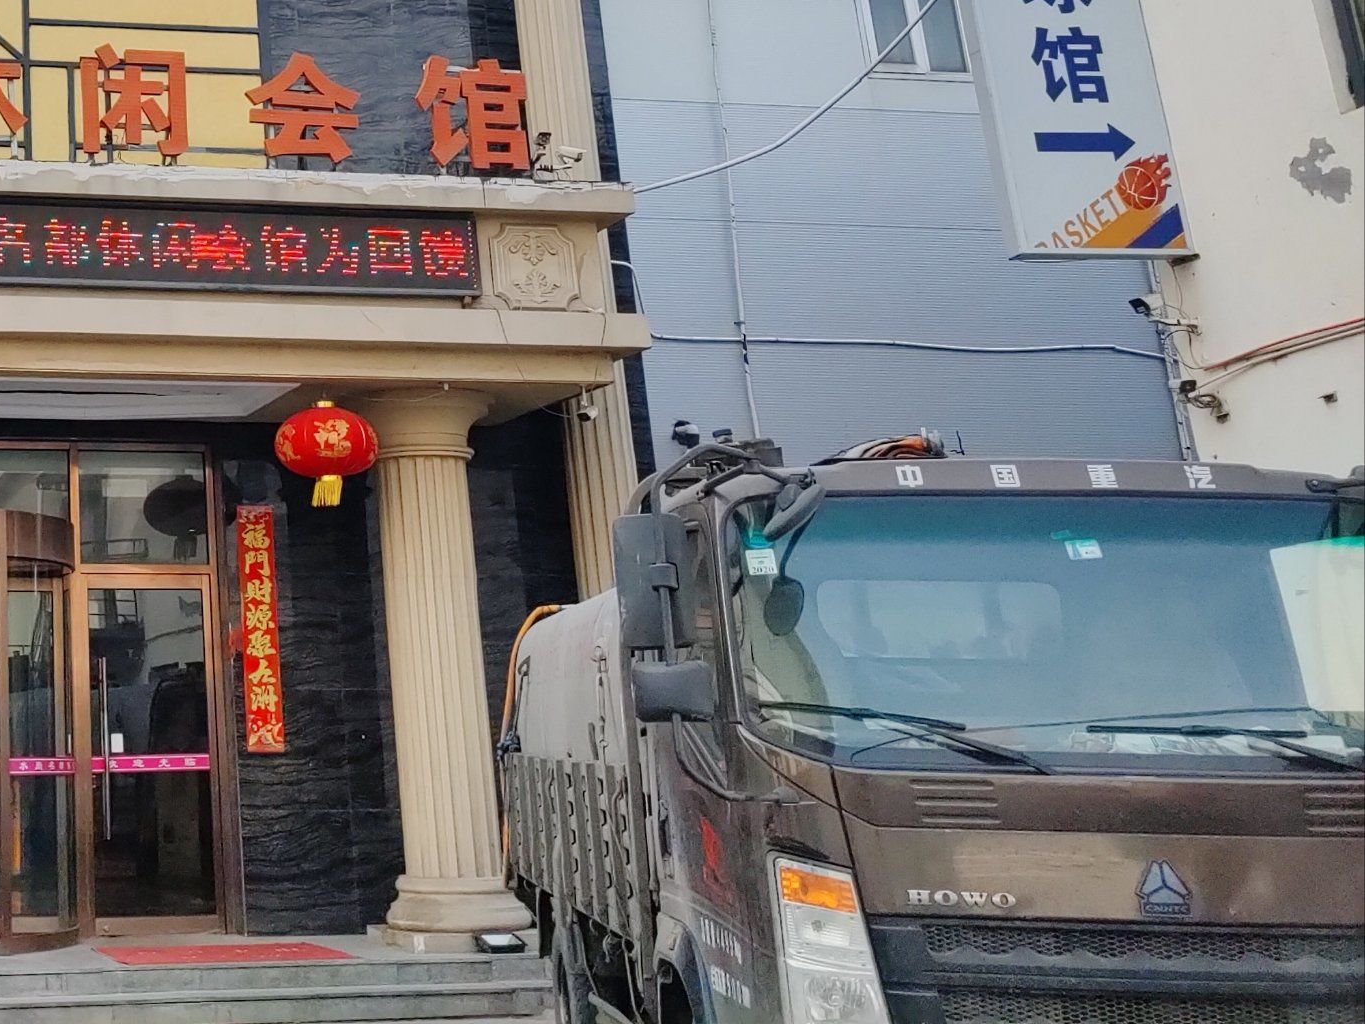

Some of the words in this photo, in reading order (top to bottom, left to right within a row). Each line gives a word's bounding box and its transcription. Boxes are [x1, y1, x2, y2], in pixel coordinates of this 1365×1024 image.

[895, 464, 1216, 489] 中国重汽
[906, 888, 1017, 909] HOWO
